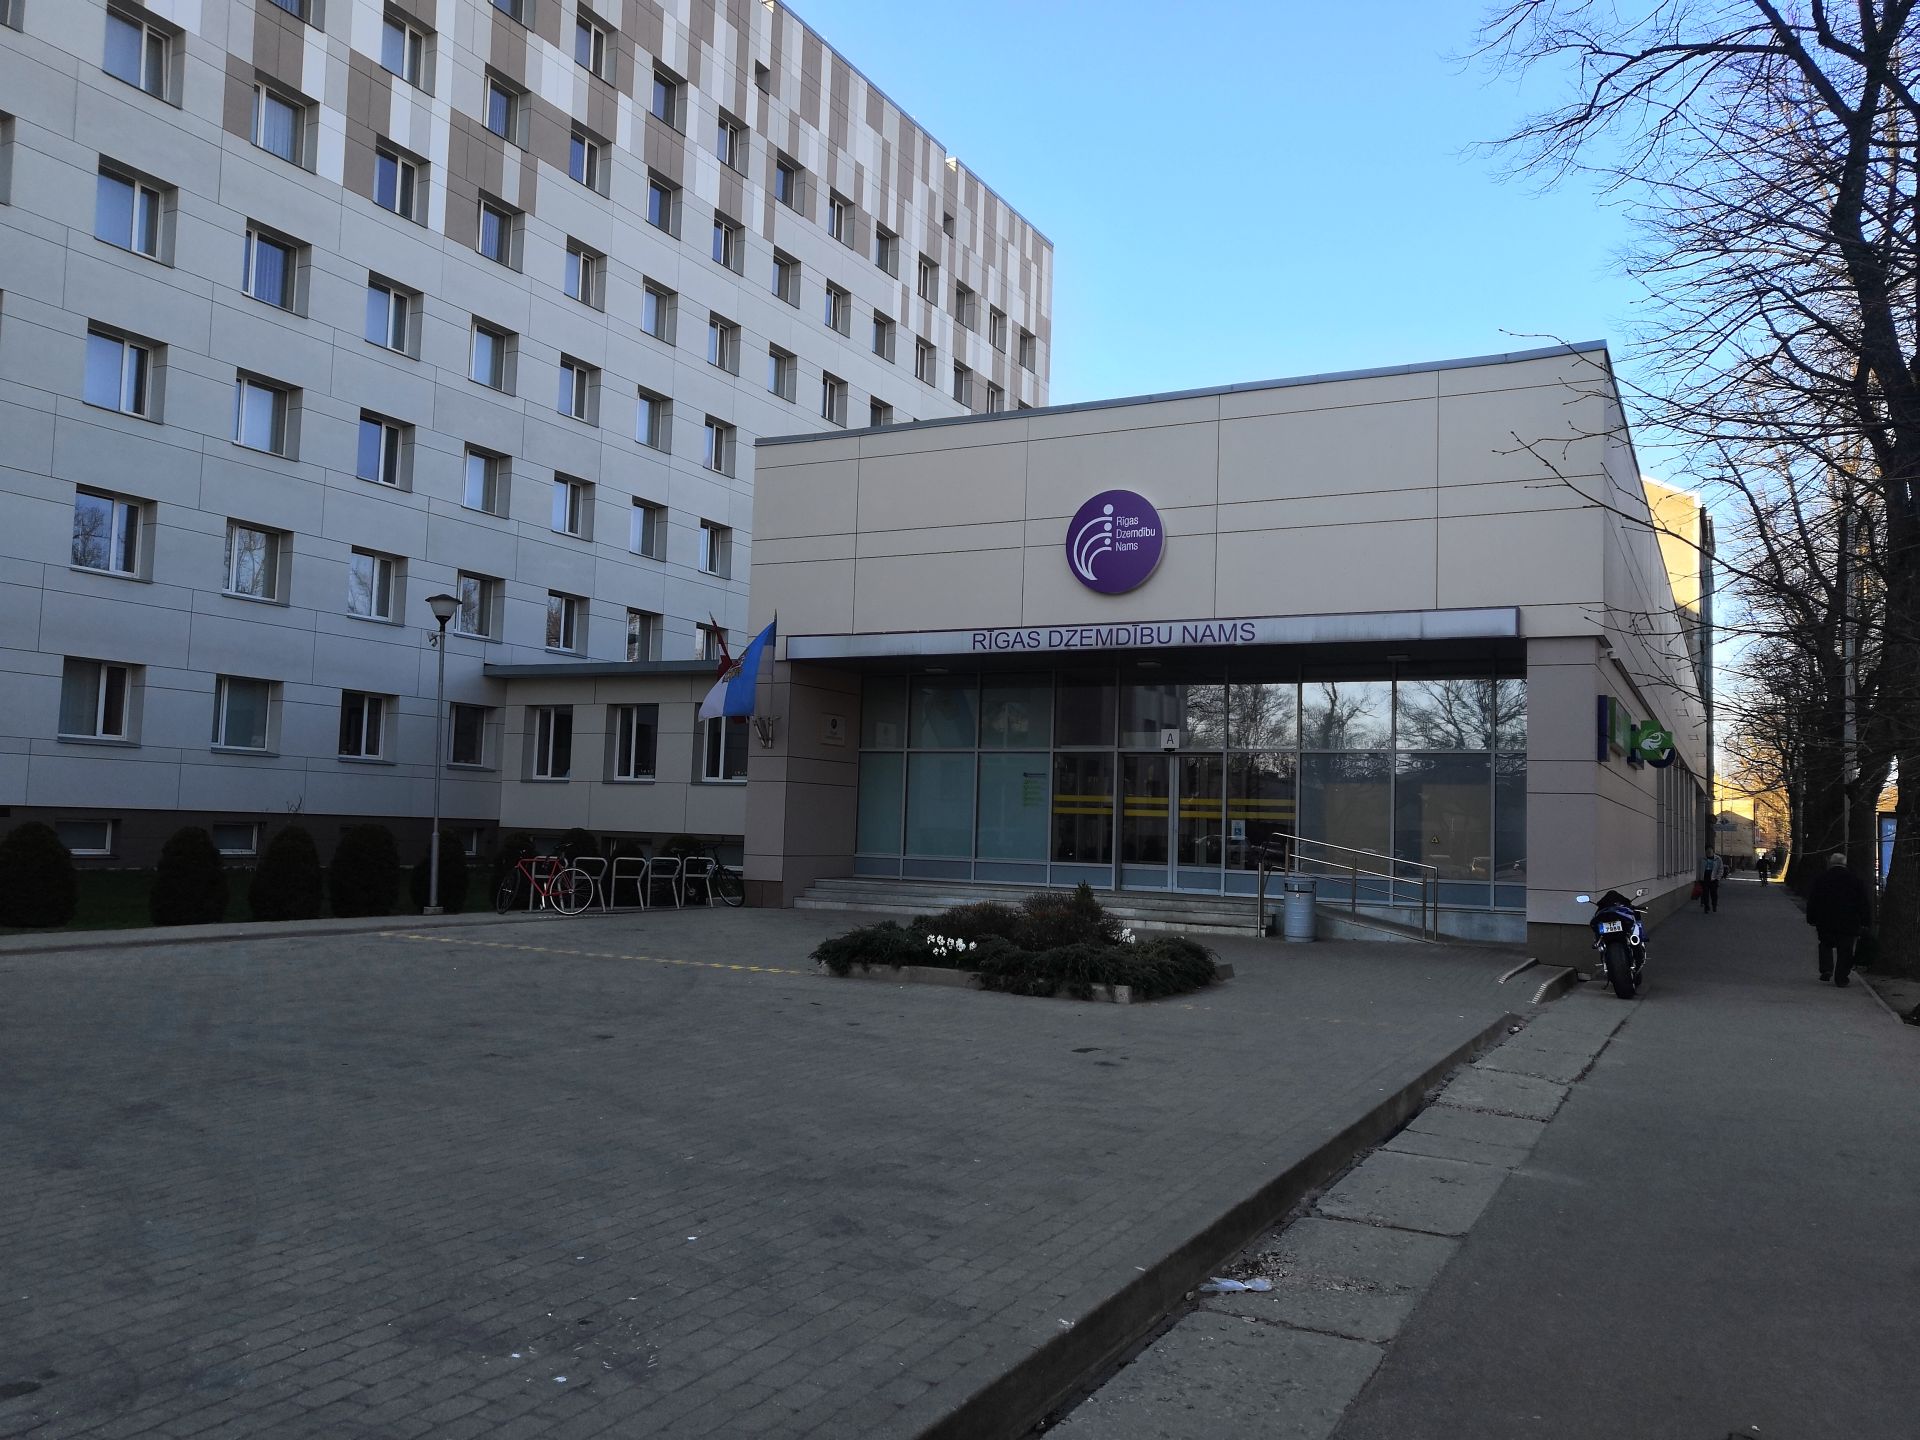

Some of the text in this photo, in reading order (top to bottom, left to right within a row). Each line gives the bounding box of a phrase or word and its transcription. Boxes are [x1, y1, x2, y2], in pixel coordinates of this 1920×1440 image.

[1116, 516, 1139, 528] Rīgas
[1116, 527, 1156, 539] Dzemdību
[1115, 542, 1139, 552] Nams
[972, 622, 1256, 650] RĪGAS DZEMDĪBU NAMS
[1166, 732, 1175, 745] A
